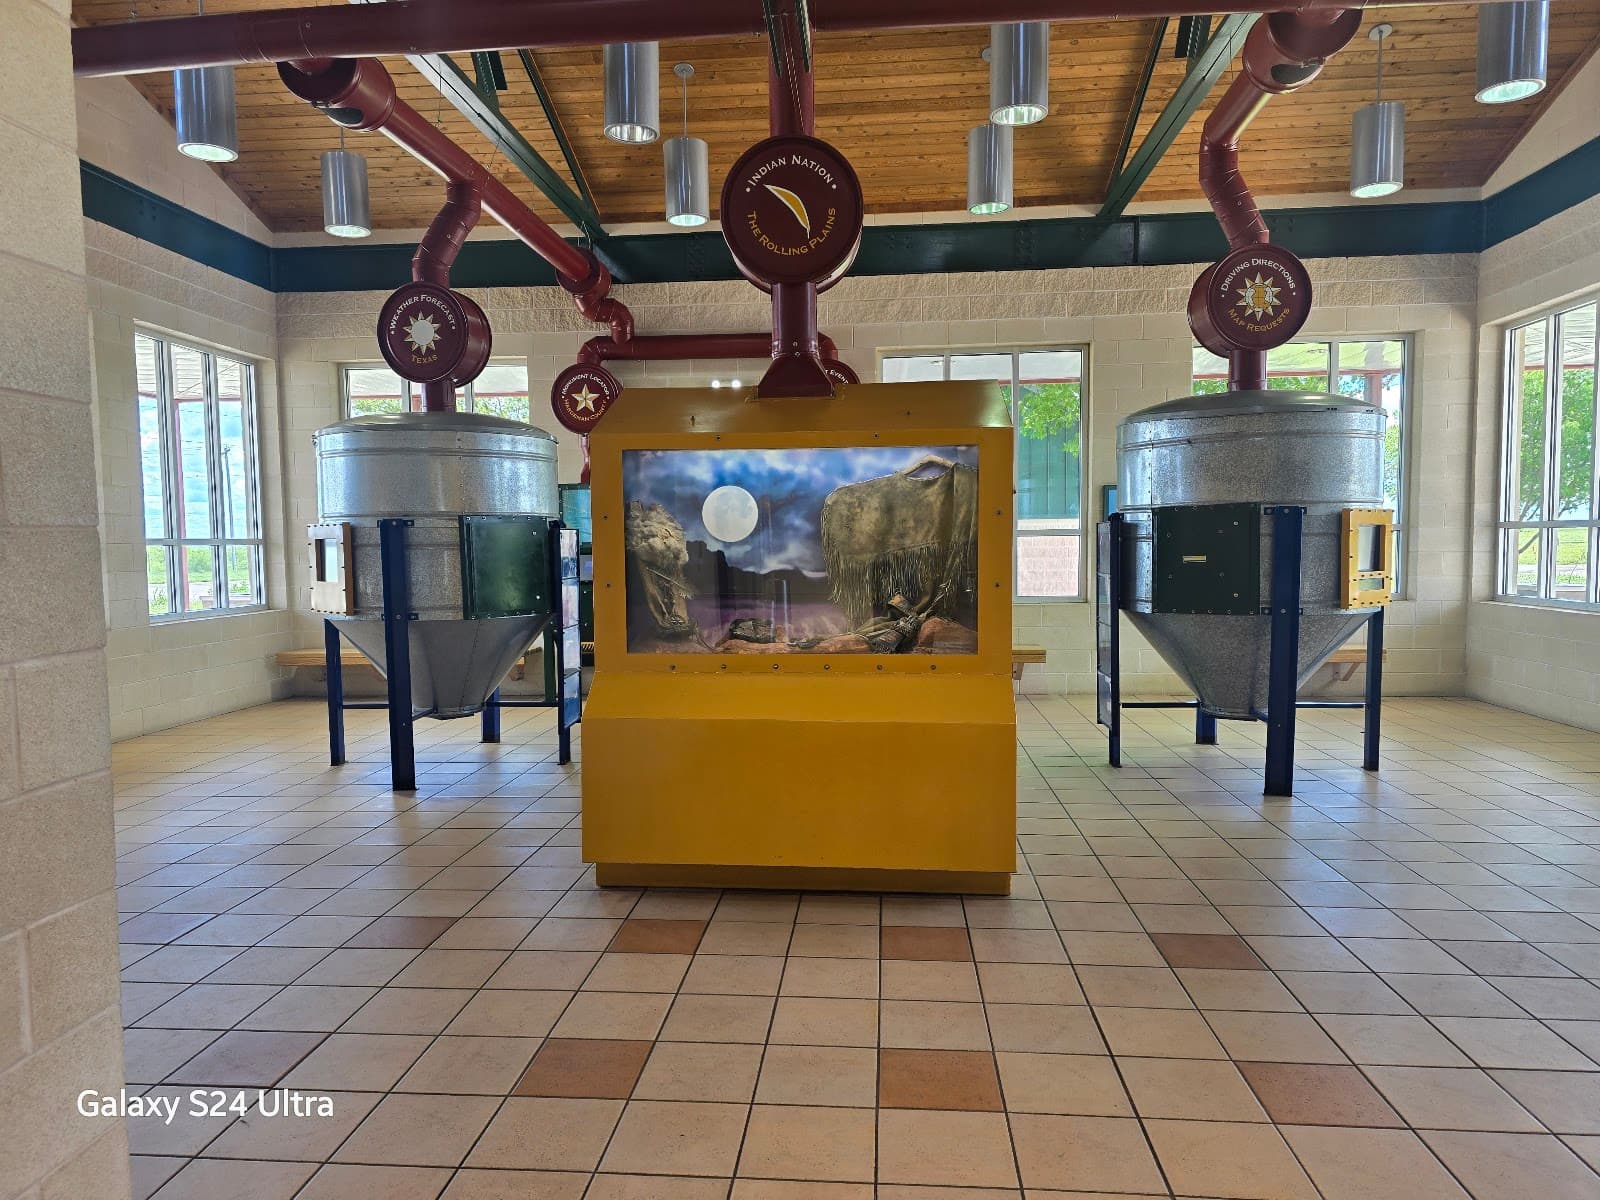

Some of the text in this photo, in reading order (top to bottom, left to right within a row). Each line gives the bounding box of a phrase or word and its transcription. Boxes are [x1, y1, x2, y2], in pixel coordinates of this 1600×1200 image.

[748, 155, 833, 186] INDIAN NATION
[748, 207, 836, 256] THE ROLLING PLAINS
[1221, 258, 1296, 292] DRIVING DIRECTIONS
[390, 294, 455, 329] WEATHER FORECAST
[1228, 307, 1290, 332] MAP REQUESTS
[412, 354, 438, 364] TEXAS
[562, 373, 609, 395] MONUMENT LOCATOR
